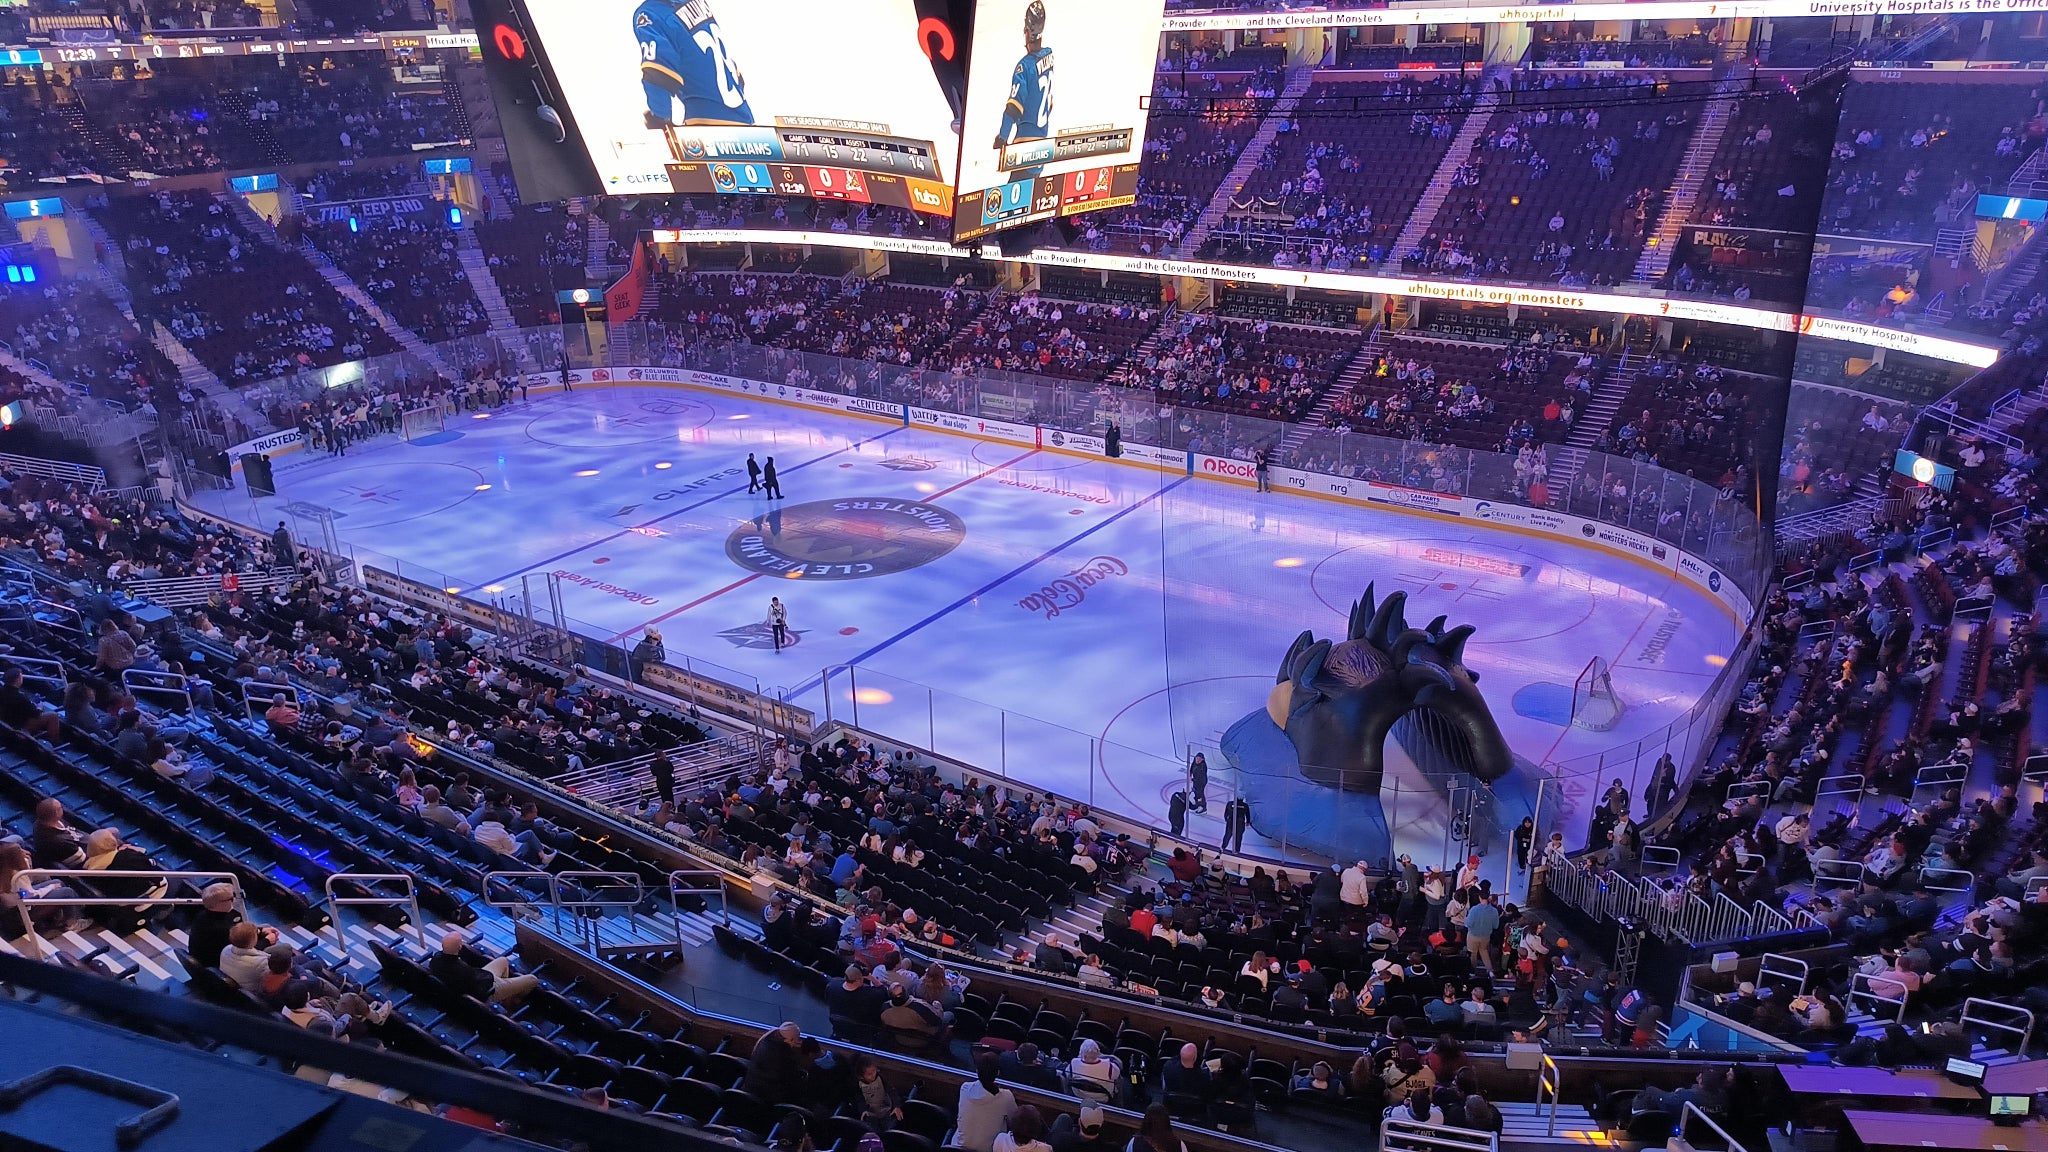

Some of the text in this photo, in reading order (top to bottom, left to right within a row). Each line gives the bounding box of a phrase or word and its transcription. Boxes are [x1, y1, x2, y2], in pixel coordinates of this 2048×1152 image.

[1811, 1, 1882, 13] University
[1887, 0, 1954, 13] Hospitals
[1959, 0, 1970, 9] is
[1977, 0, 2000, 9] the
[1169, 19, 1206, 29] Provider
[1247, 18, 1263, 27] and
[1267, 16, 1283, 26] the
[1285, 15, 1333, 25] Cleveland
[1336, 14, 1383, 24] Monsters
[277, 42, 285, 52] 0
[428, 37, 457, 45] fficial
[10, 50, 20, 63] 0
[58, 48, 96, 61] 12:39
[152, 45, 162, 58] 0
[716, 142, 773, 156] WILLIAMS
[1022, 150, 1049, 162] WILLIAMS
[1060, 147, 1067, 155] 71
[1074, 145, 1081, 153] 15
[1087, 142, 1095, 152] 22
[792, 143, 925, 171] 71 15 22 -1 14
[626, 173, 669, 184] CLIFFS
[744, 164, 759, 184] 0
[819, 168, 832, 188] 0
[1075, 172, 1085, 191] 0
[780, 182, 806, 194] 12:39
[1011, 183, 1021, 205] 0
[914, 187, 941, 206] fubo
[964, 192, 982, 203] PENALTY
[1035, 195, 1058, 211] 12:39
[30, 200, 38, 216] S
[354, 202, 391, 217] EEP
[394, 199, 425, 213] END
[2002, 198, 2021, 219] N
[1694, 231, 1728, 246] PLAY
[873, 240, 909, 252] University
[912, 243, 946, 254] Hospitals
[1051, 254, 1087, 264] Provider
[1125, 260, 1256, 280] and the Cleveland Monsters
[1408, 284, 1584, 307] uhhospitals org/monsters
[1816, 319, 1918, 345] University Hospitals
[856, 398, 886, 412] CENTER
[886, 405, 899, 414] ICE
[1218, 460, 1257, 477] Rock
[653, 467, 744, 501] CLIFFS
[1289, 474, 1306, 488] nrg
[1330, 482, 1348, 496] nrg
[999, 479, 1098, 502] Rocket Arena
[833, 501, 952, 533] MONSTERS
[1491, 511, 1526, 521] CENTURY
[1599, 532, 1650, 553] MONSTERS HOCKEY
[740, 536, 875, 575] CLEVELAND
[551, 570, 646, 602] Rocket Arena
